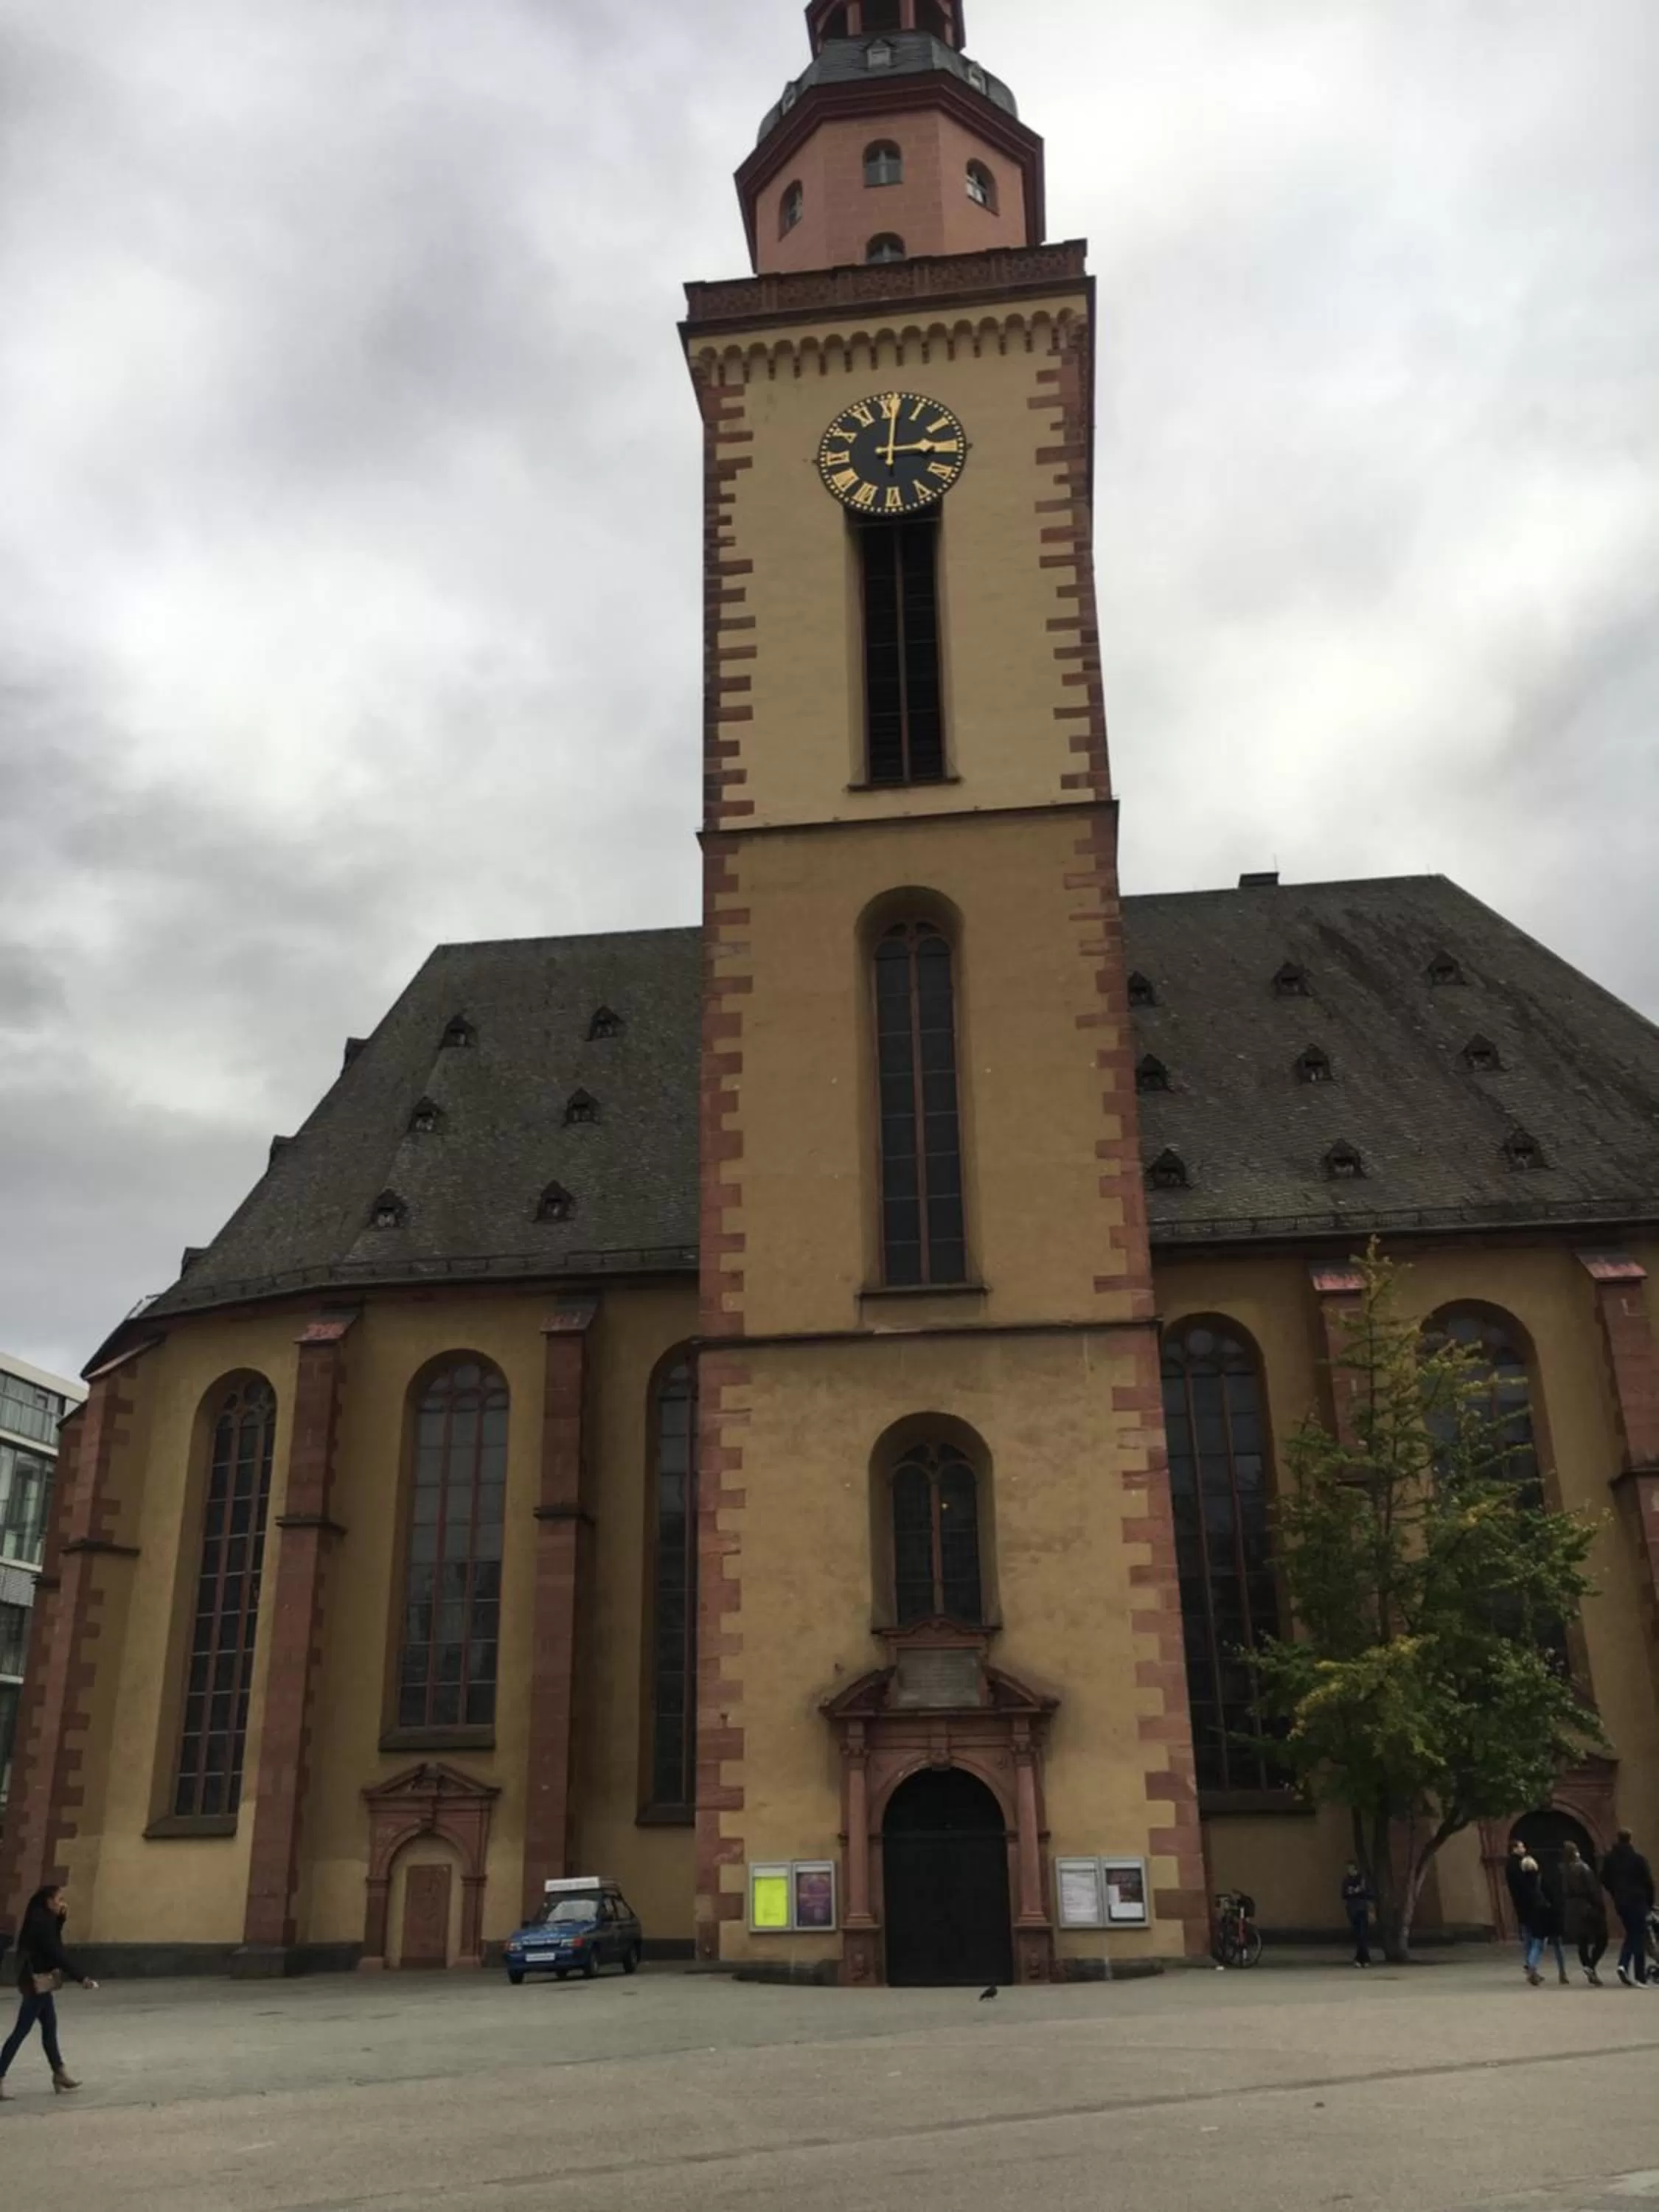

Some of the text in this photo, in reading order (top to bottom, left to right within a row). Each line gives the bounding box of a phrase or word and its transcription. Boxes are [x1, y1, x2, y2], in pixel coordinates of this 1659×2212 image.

[852, 406, 875, 427] XI
[908, 402, 925, 420] I
[832, 428, 857, 443] X
[826, 450, 849, 467] IX
[885, 486, 903, 507] VI
[912, 479, 931, 499] V
